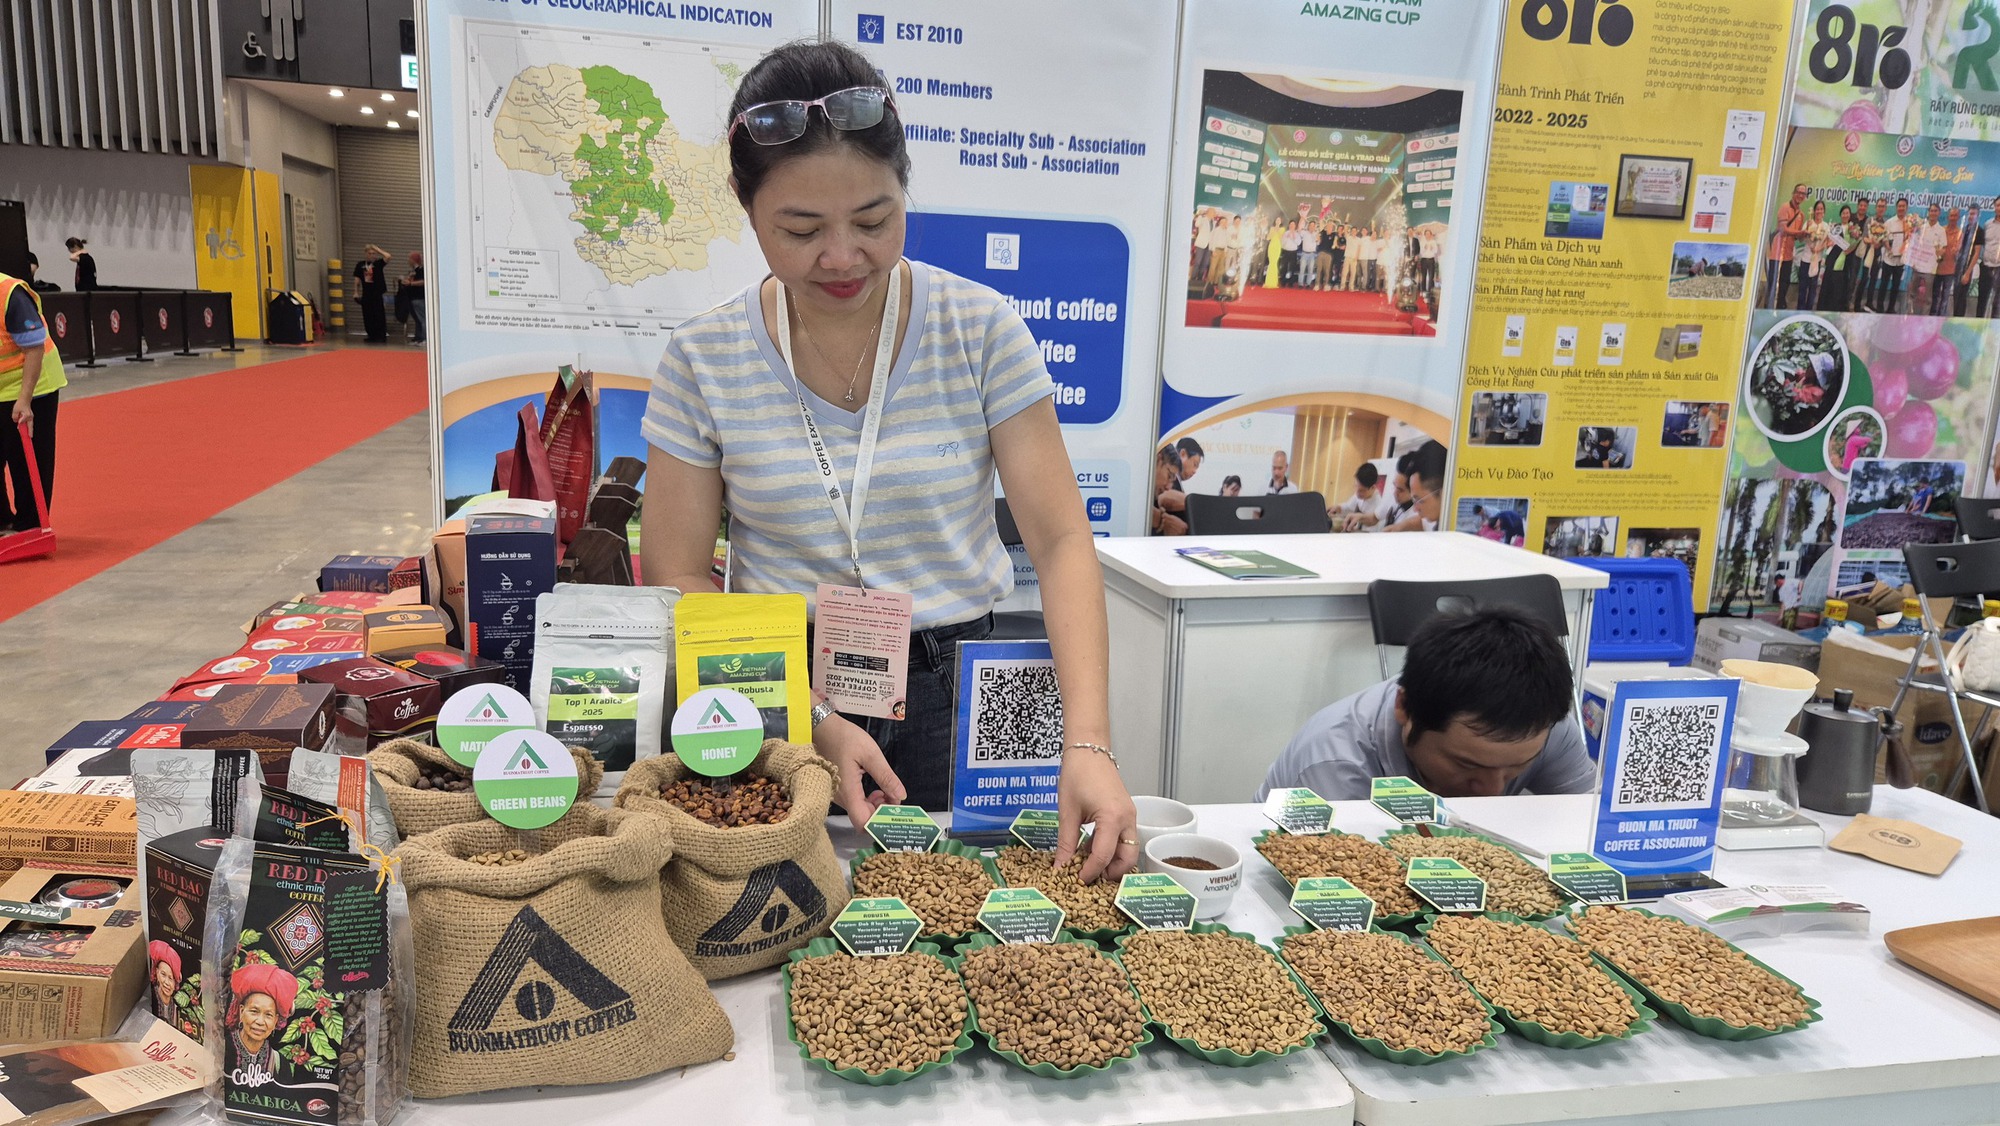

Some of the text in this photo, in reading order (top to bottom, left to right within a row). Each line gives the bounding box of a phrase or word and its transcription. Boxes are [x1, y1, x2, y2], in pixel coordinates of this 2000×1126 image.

[1300, 2, 1421, 25] AMAZING CUP
[1693, 3, 1710, 14] Công
[680, 5, 773, 28] INDICATION
[897, 23, 963, 44] EST 2010
[896, 77, 993, 100] 200 Members
[1530, 86, 1561, 100] Trình
[1564, 88, 1591, 103] Phát
[484, 86, 504, 118] CAMPUCHIA
[1495, 107, 1588, 129] 2022 2025
[905, 124, 1146, 156] ffiliate: Specialty Sub Association
[960, 149, 1120, 176] Roast Sub Association
[1815, 188, 1825, 201] 10
[1480, 236, 1601, 254] Sản Phẩm và Dịch vụ
[1518, 255, 1528, 265] và
[1530, 256, 1544, 266] Gia
[1546, 256, 1571, 268] Công
[1572, 257, 1597, 268] Nhân
[1599, 258, 1623, 269] xanh
[1492, 285, 1519, 296] Phẩm
[1520, 286, 1544, 298] Rang
[1545, 286, 1560, 298] hạt
[1563, 289, 1586, 299] rang
[1004, 295, 1117, 322] huot coffee
[1040, 339, 1076, 363] ffee
[1468, 366, 1489, 376] Dịch
[1508, 366, 1538, 378] Nghiên
[1561, 368, 1581, 379] phát
[1705, 371, 1718, 381] Gia
[1466, 377, 1490, 388] Công
[1493, 378, 1509, 388] Hạt
[1512, 378, 1535, 389] Rang
[805, 414, 831, 476] COFFEE EXPO
[1095, 473, 1109, 482] US
[1457, 467, 1554, 481] Dịch Vụ Đào Tạo
[825, 680, 877, 693] COFFEE EXPO
[826, 673, 877, 686] VIETNAM 2025
[565, 699, 581, 707] Top
[394, 704, 420, 719] Coffee
[582, 708, 603, 716] 2025
[701, 746, 738, 761] HONEY
[977, 776, 1027, 789] BUON MA
[490, 796, 567, 811] GREEN BEANS
[964, 793, 1058, 806] COFFEE ASSOCIATI
[270, 801, 297, 821] RED
[1618, 818, 1699, 833] BUON MA THUOT
[1604, 836, 1707, 852] COFFEE ASSOCIATION
[267, 863, 308, 881] RED
[1209, 872, 1238, 884] VIETNAM
[157, 866, 204, 897] RED DAO
[276, 880, 304, 891] ethnic
[1204, 883, 1229, 892] Amazing
[696, 929, 791, 957] BUONMATHUOT
[874, 945, 898, 953] 85.17
[449, 1000, 638, 1053] BUONMATHUOT COFFEE
[232, 1063, 274, 1088] Coffee
[229, 1090, 303, 1113] ARABICA
